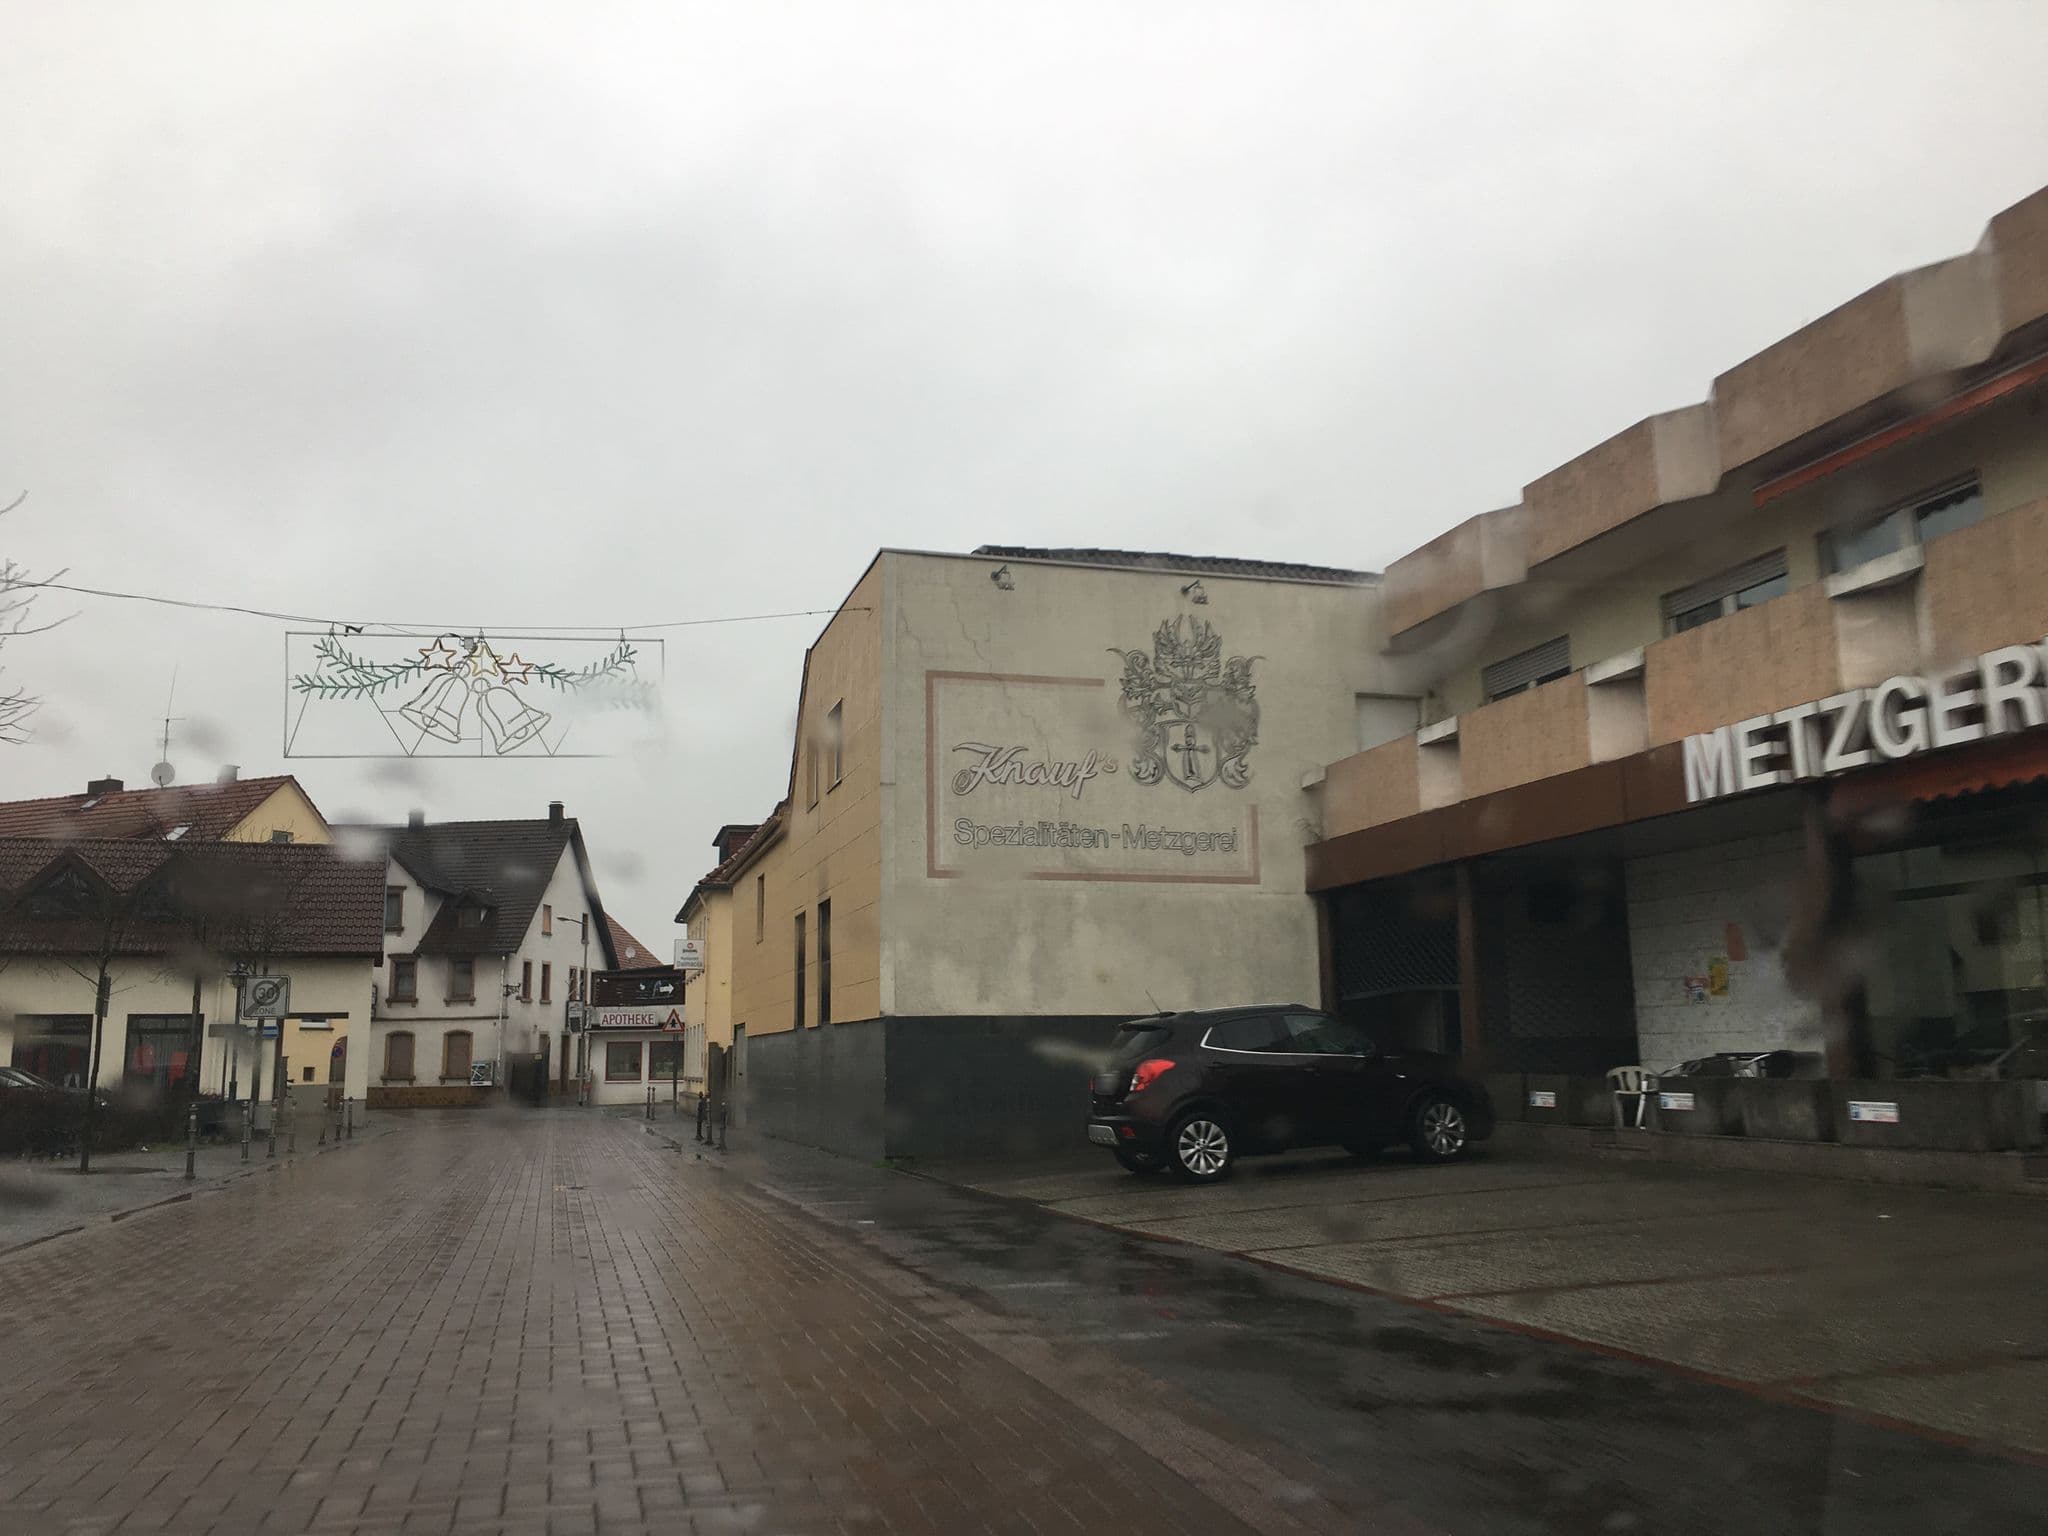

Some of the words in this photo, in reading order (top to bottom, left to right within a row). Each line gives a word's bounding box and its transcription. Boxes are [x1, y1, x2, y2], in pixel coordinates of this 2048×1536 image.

[1683, 636, 2048, 804] METZGER
[952, 741, 1119, 800] Knauf's
[953, 817, 1239, 856] Spezialitäten-Metzgerei
[258, 986, 275, 1000] 30
[601, 1013, 655, 1025] APOTHEKE
